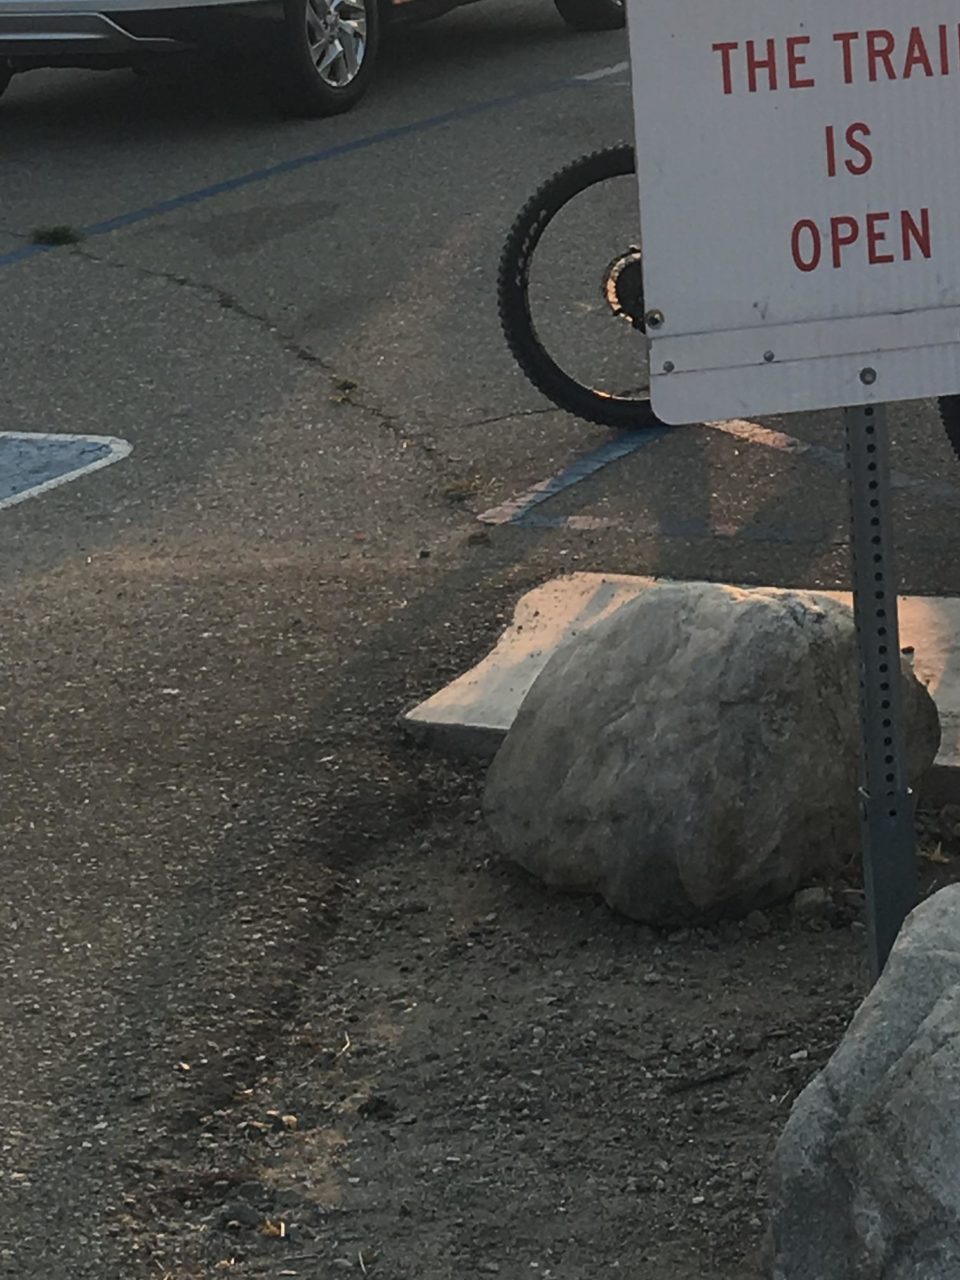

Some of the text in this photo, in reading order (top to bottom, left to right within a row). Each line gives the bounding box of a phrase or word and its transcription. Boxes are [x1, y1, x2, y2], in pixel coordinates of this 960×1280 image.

[712, 34, 815, 95] THE
[825, 122, 873, 177] IS
[790, 207, 932, 273] OPEN
